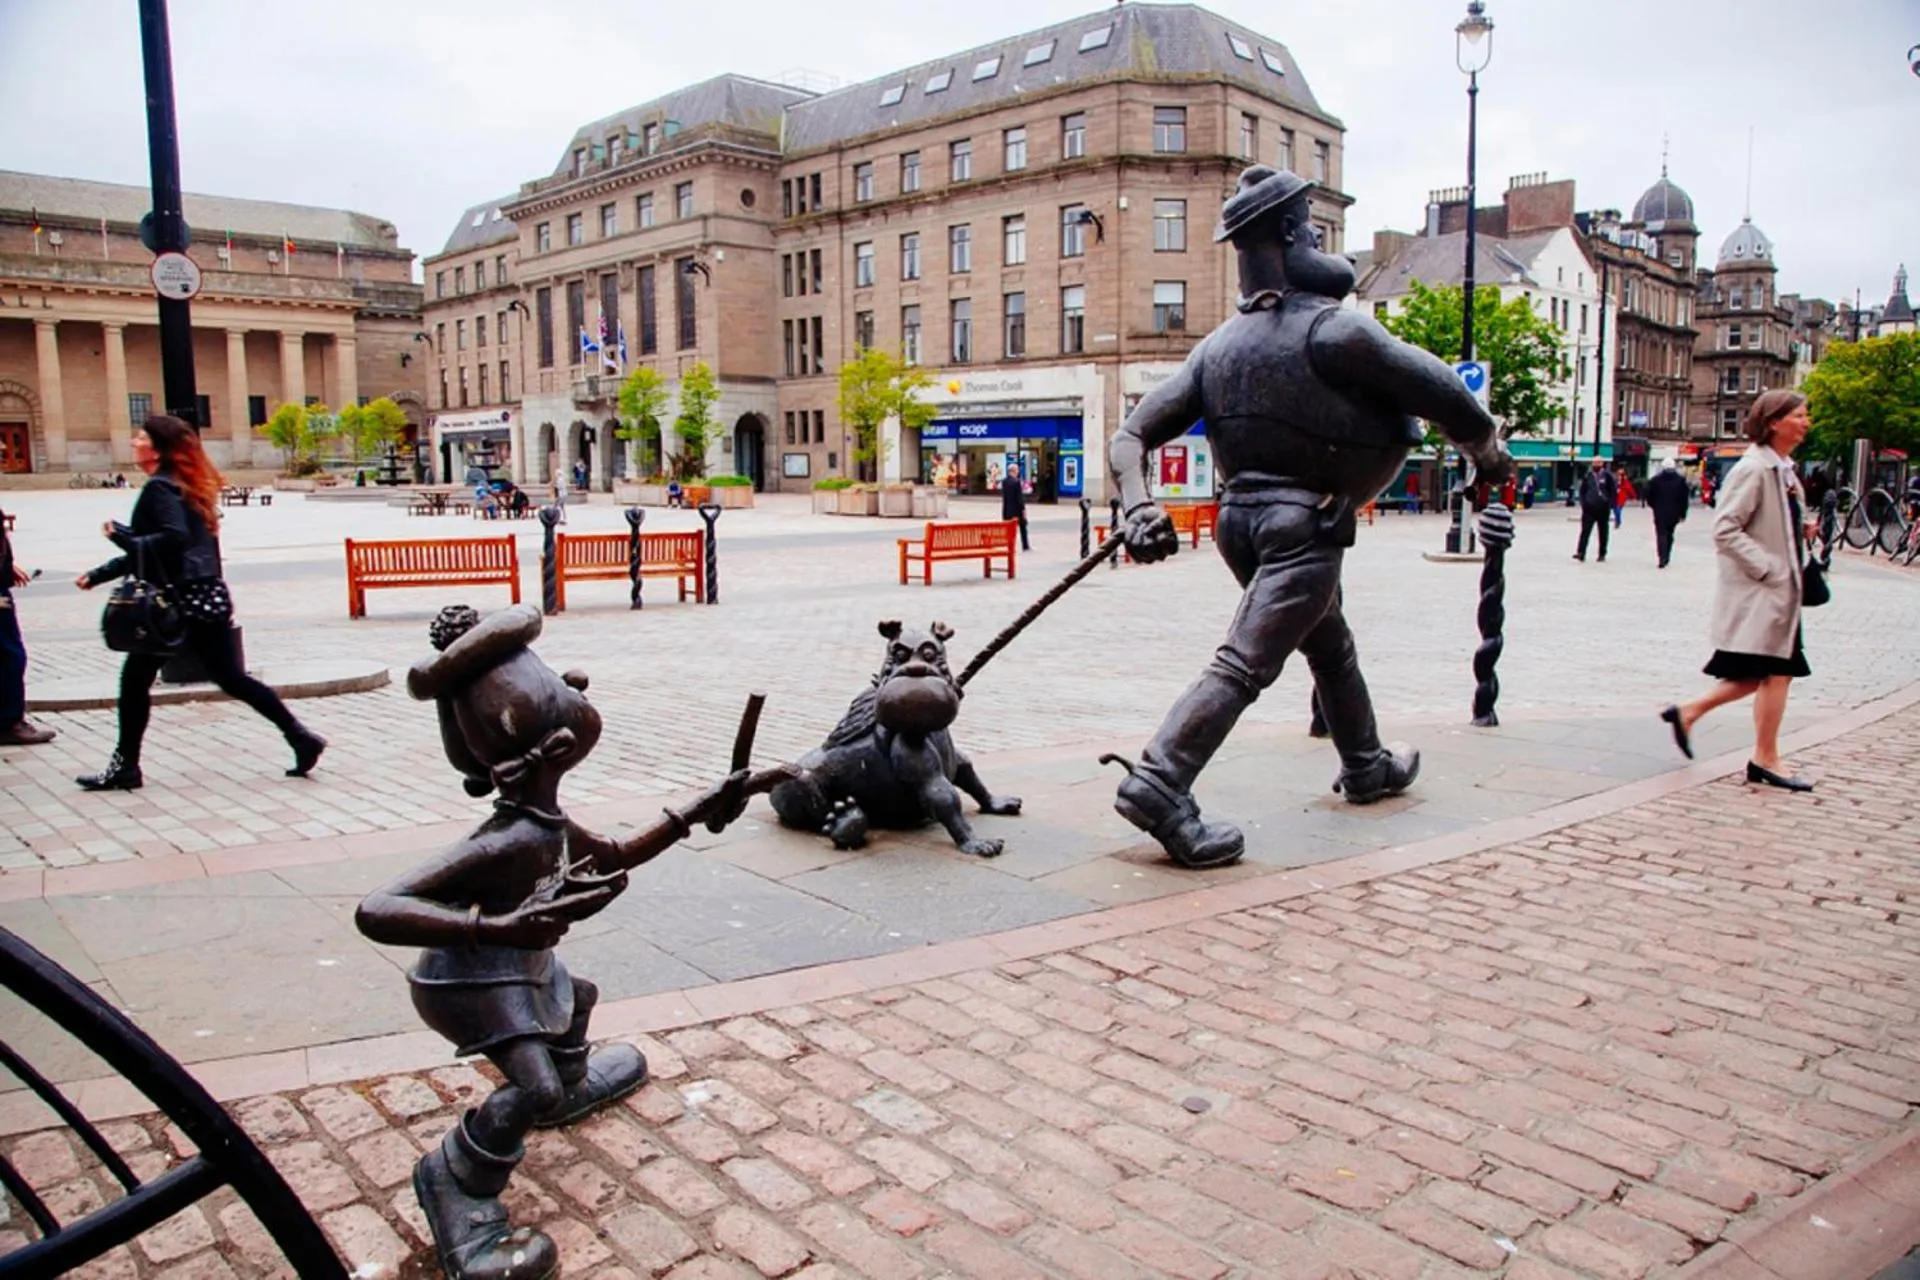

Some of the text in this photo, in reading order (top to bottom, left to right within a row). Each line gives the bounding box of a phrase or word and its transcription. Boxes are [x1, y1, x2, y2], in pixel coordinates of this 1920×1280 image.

[0, 294, 54, 310] LL
[1140, 371, 1175, 382] Thom
[965, 379, 1023, 393] Thomas Cook
[959, 424, 988, 437] escape
